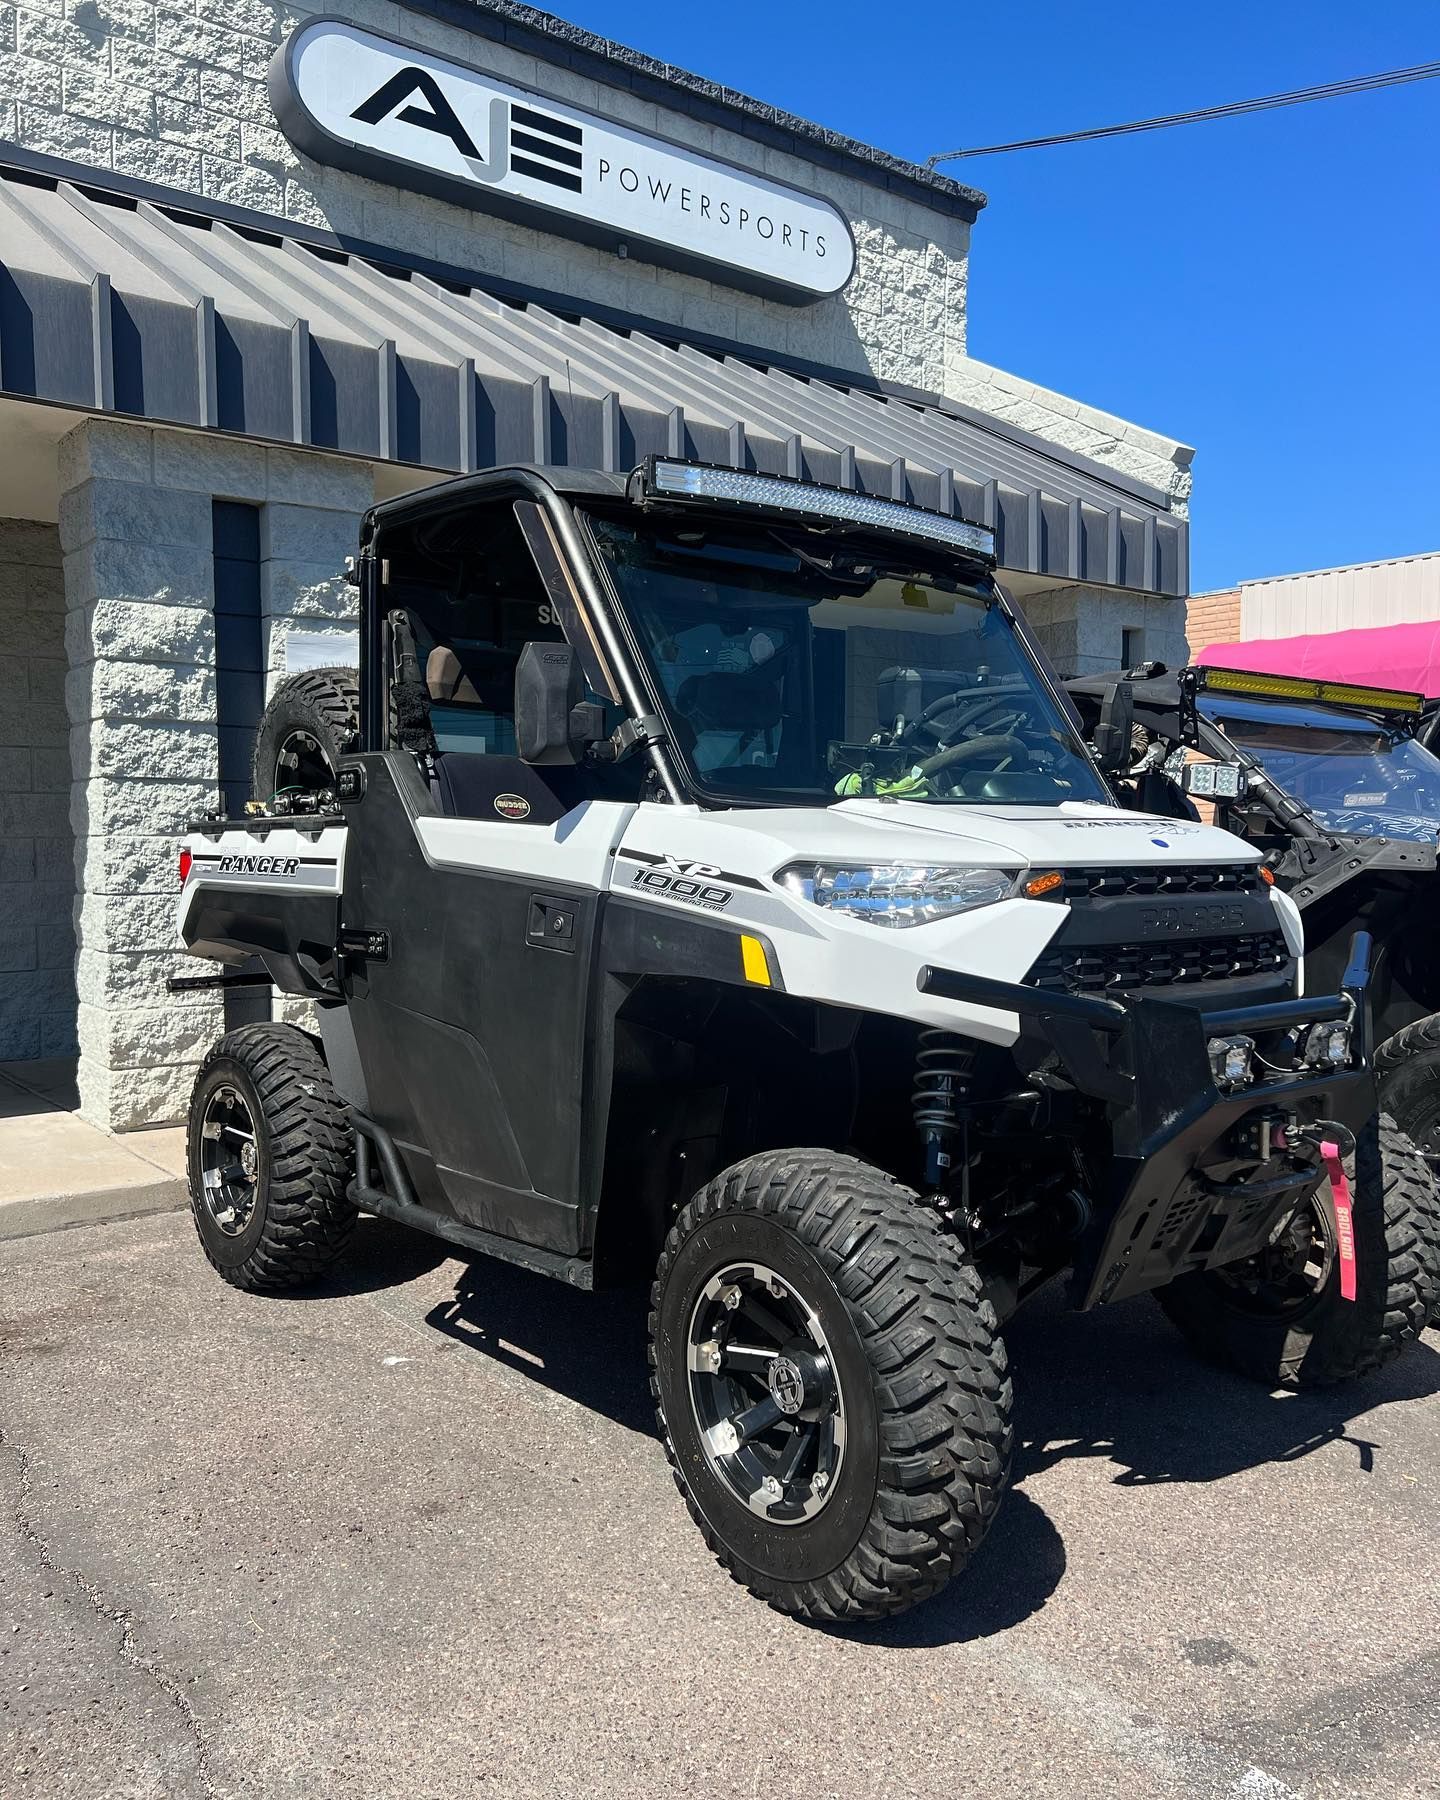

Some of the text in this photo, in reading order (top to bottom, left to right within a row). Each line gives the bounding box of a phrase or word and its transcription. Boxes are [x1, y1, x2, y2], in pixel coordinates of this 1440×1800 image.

[350, 66, 827, 258] AJE POWERSPORTS
[218, 855, 300, 877] RANGER
[646, 853, 722, 877] XP
[631, 884, 724, 912] DUAL OVERHEAD CAM
[632, 868, 734, 906] 1000
[1336, 1206, 1353, 1259] BADLAND
